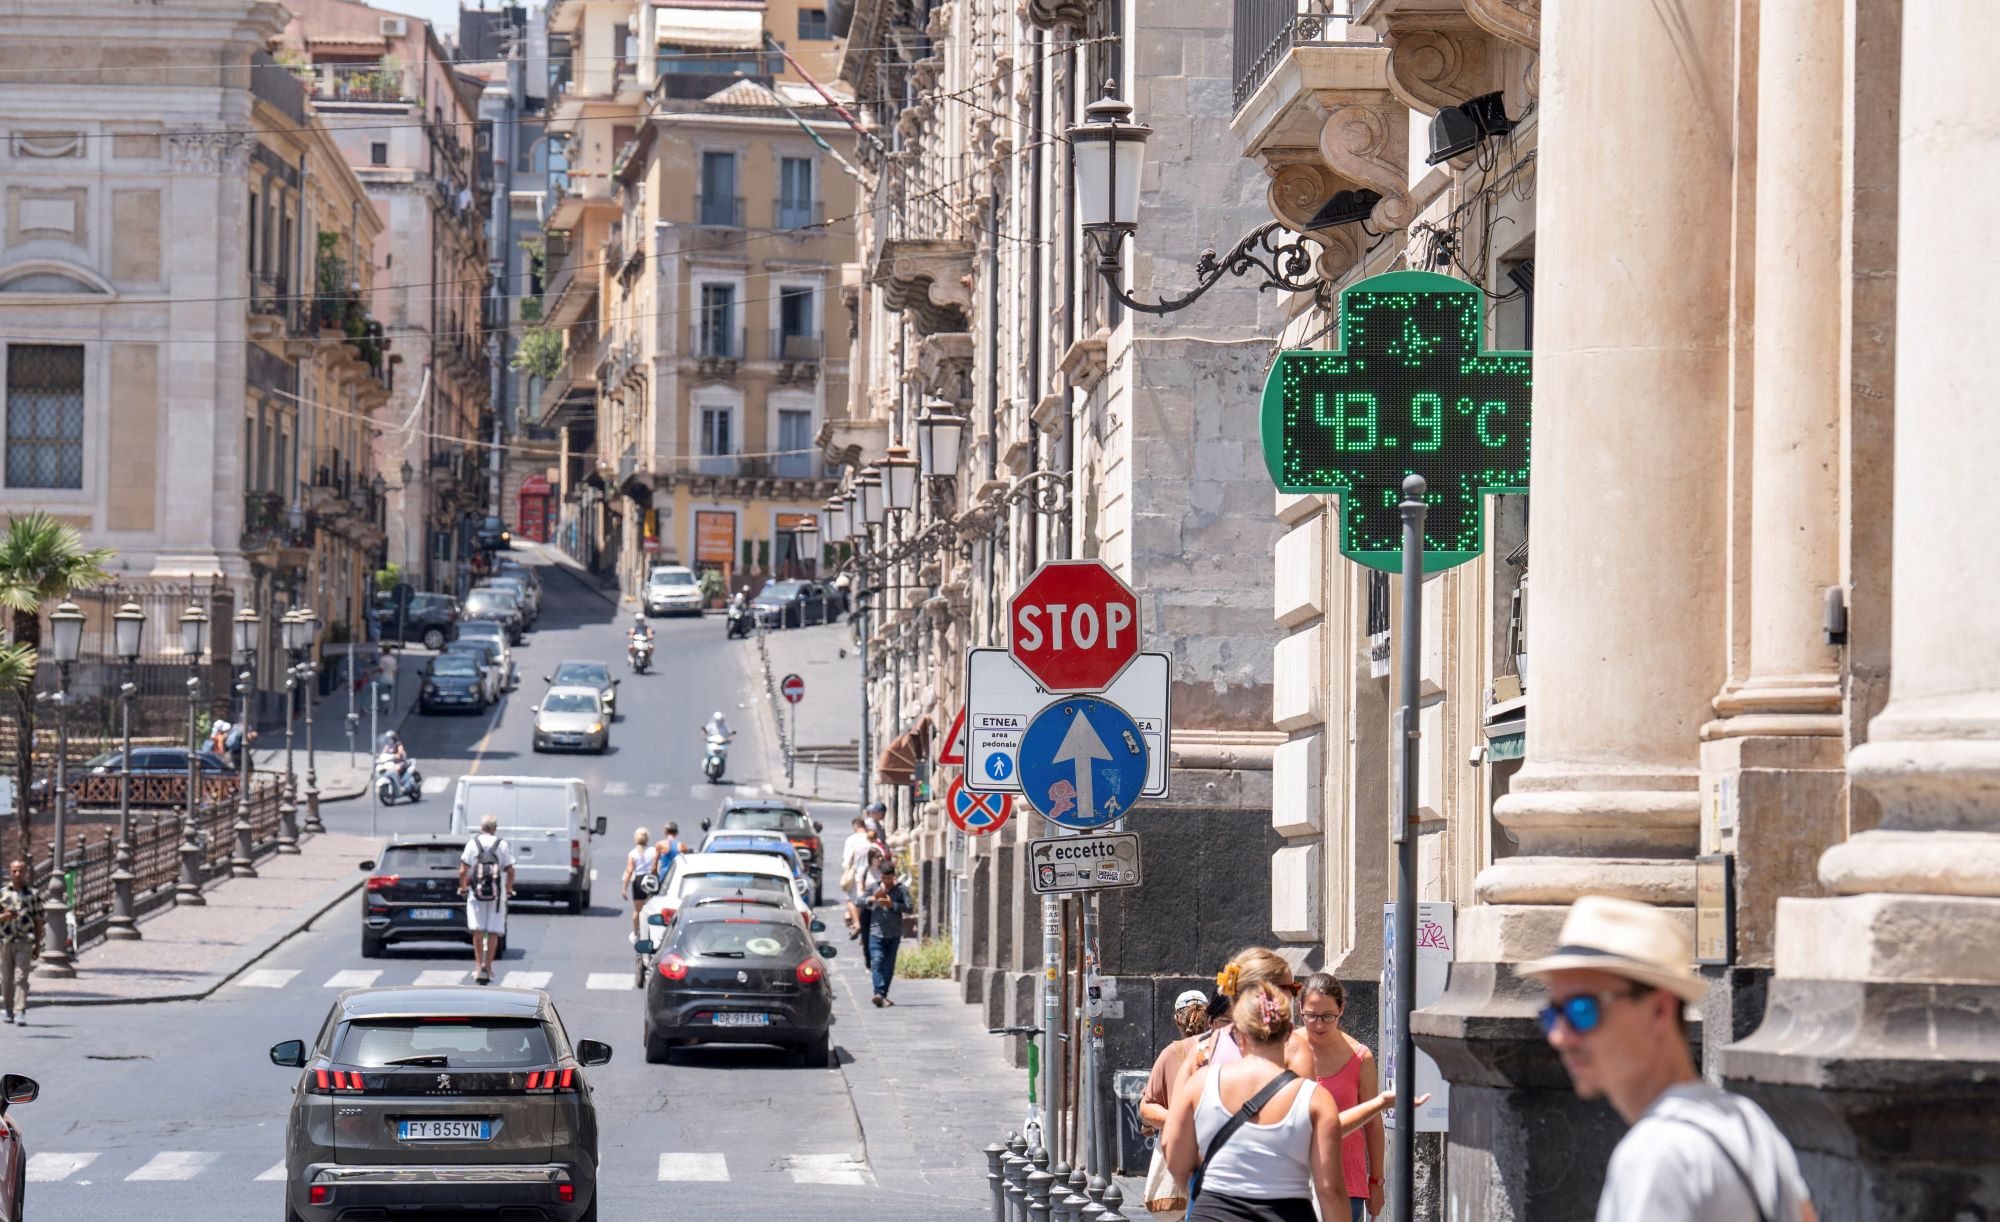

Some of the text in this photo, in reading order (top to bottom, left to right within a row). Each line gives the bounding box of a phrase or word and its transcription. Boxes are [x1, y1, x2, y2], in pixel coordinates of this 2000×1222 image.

[1315, 393, 1442, 450] 43.9
[1018, 602, 1132, 651] STOP
[982, 717, 1018, 727] ETNEA
[1136, 721, 1153, 731] EA
[982, 740, 1017, 749] pedonale
[1055, 841, 1115, 860] eccetto
[433, 1122, 480, 1137] 855YN
